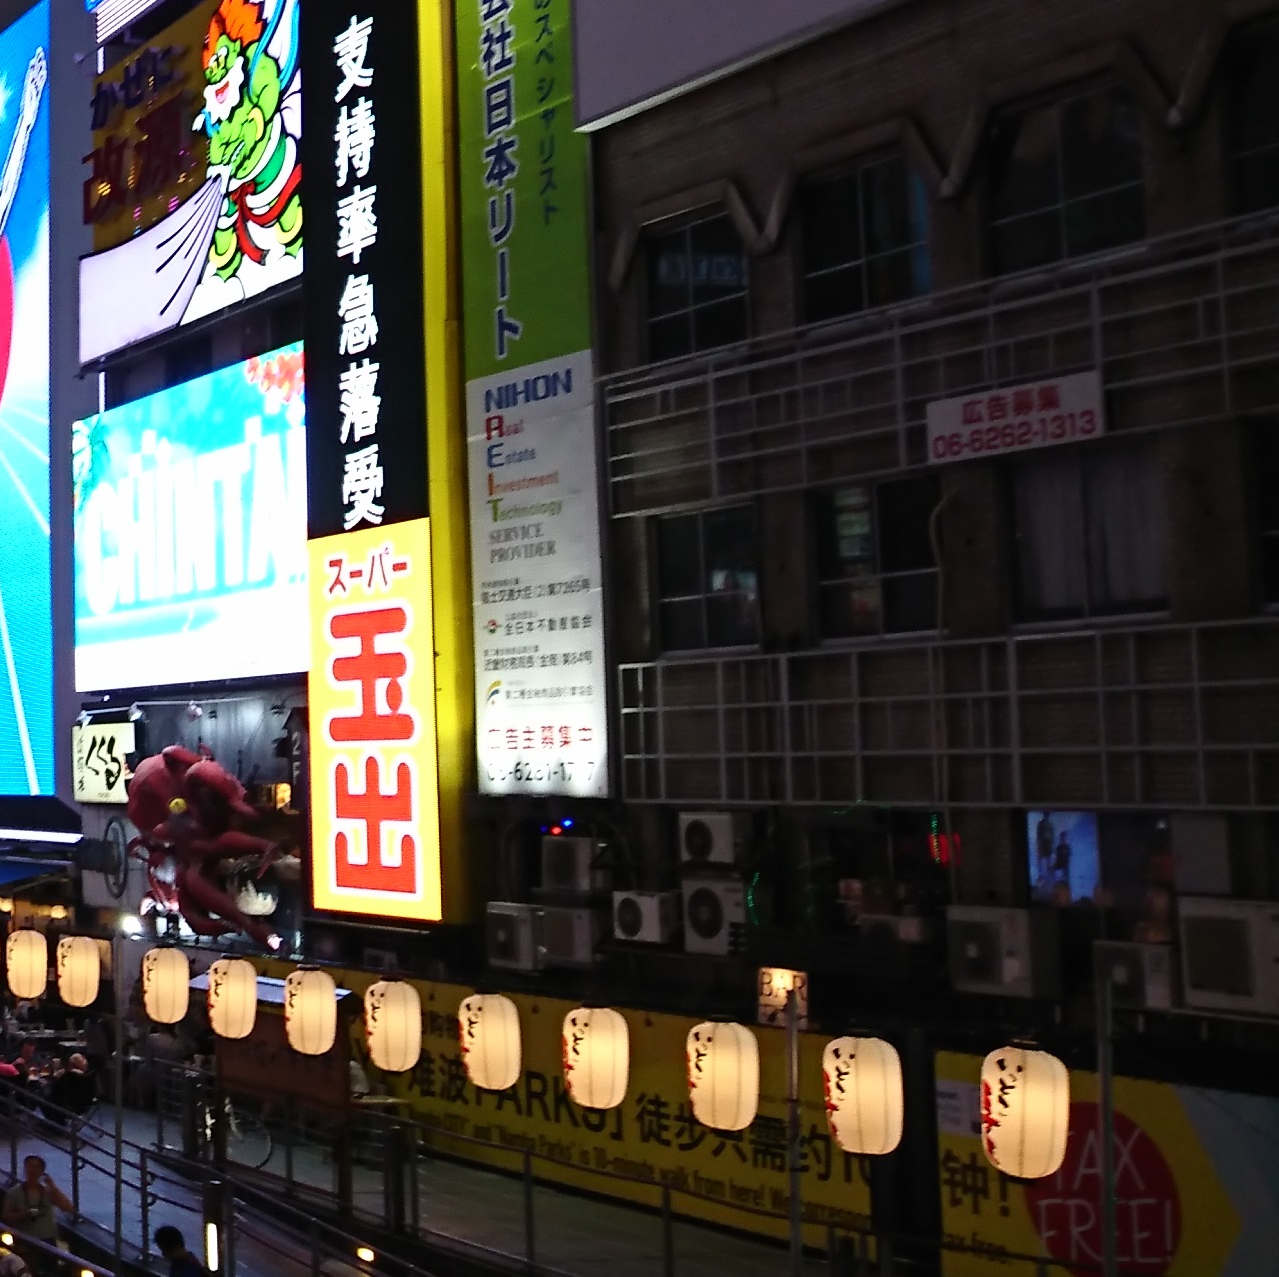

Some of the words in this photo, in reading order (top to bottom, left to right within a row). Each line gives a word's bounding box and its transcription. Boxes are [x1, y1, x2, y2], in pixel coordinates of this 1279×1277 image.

[485, 367, 573, 414] NIHON
[962, 385, 1062, 426] 広告募集
[931, 408, 1098, 459] 06-6262-1313
[488, 521, 545, 547] SERVICE
[489, 539, 557, 567] PROVIDER
[326, 545, 409, 597] スーパー
[328, 605, 419, 894] 玉出
